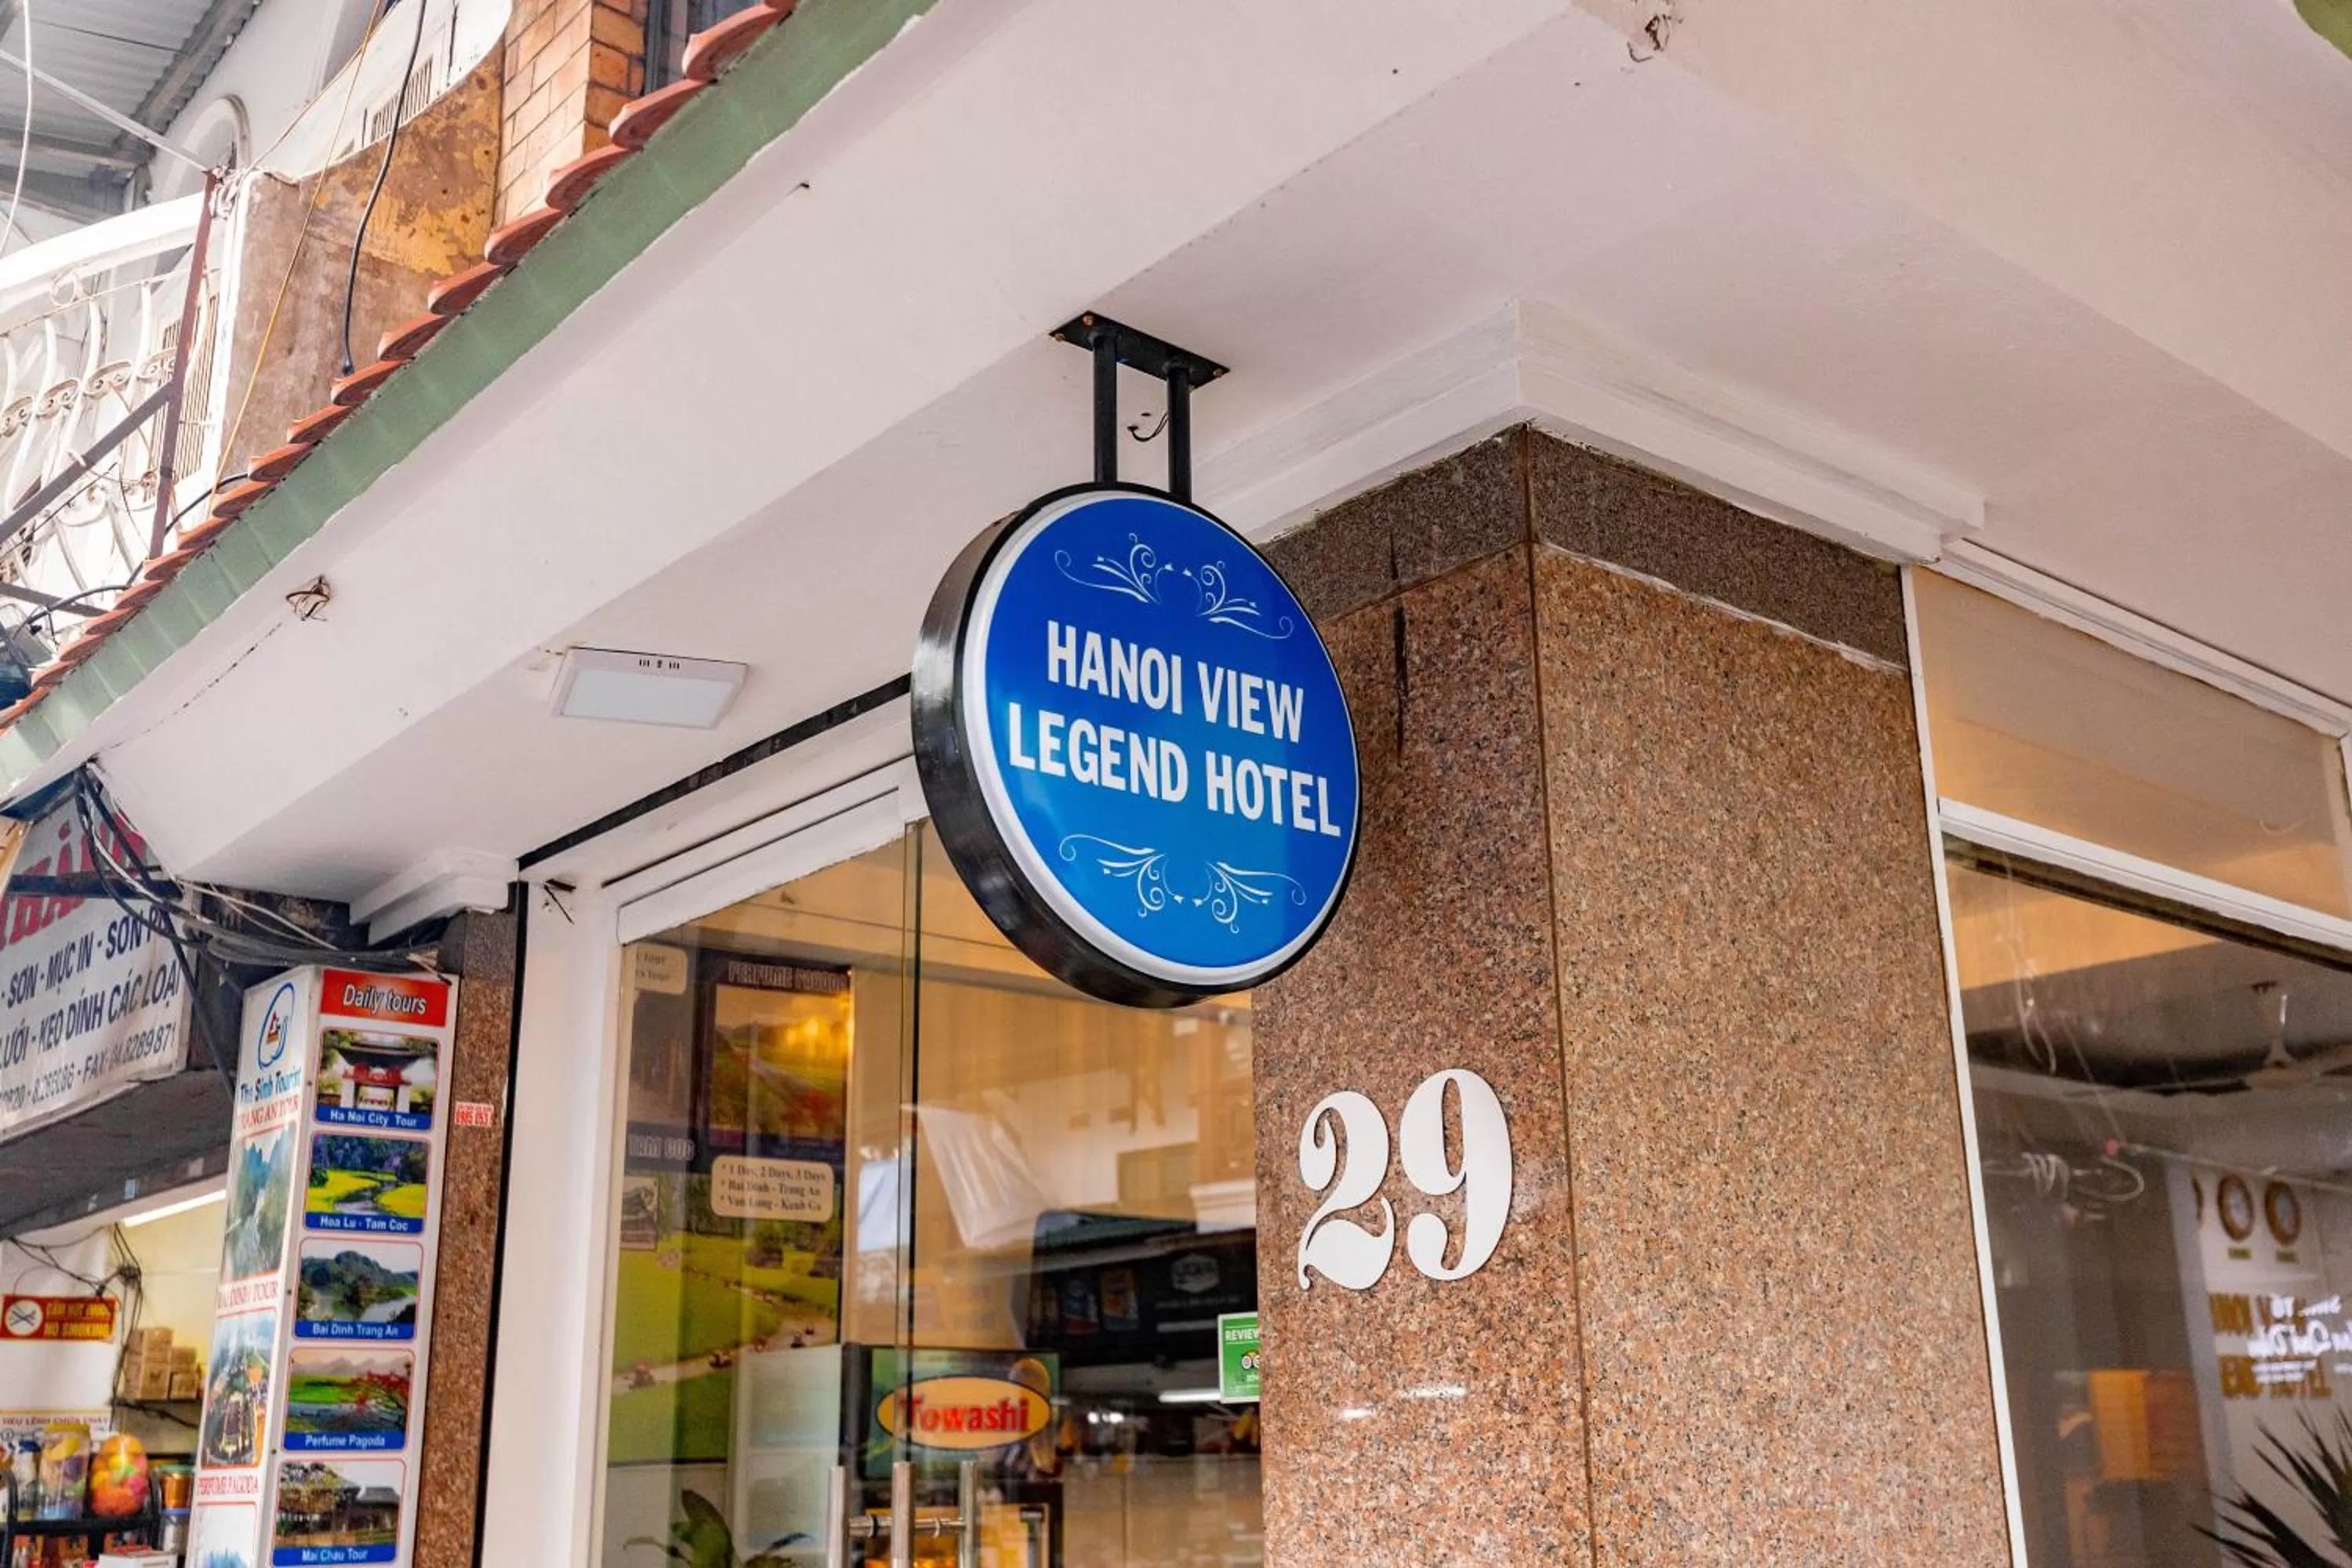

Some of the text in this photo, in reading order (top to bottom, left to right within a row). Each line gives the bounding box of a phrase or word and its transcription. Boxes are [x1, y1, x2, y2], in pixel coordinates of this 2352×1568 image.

[1047, 619, 1305, 744] HANOI VIEW
[1008, 701, 1341, 837] LEGEND HOTEL
[343, 983, 427, 1015] Daily tours
[330, 1110, 418, 1127] Ha Noi City Tour
[1298, 1068, 1513, 1291] 29
[320, 1216, 409, 1232] Hoa Lu Tam Coc
[313, 1323, 399, 1338] Bai Dinh Trang An
[305, 1434, 386, 1449] Perfume Pagoda
[302, 1548, 369, 1562] Mai Chau Tour
